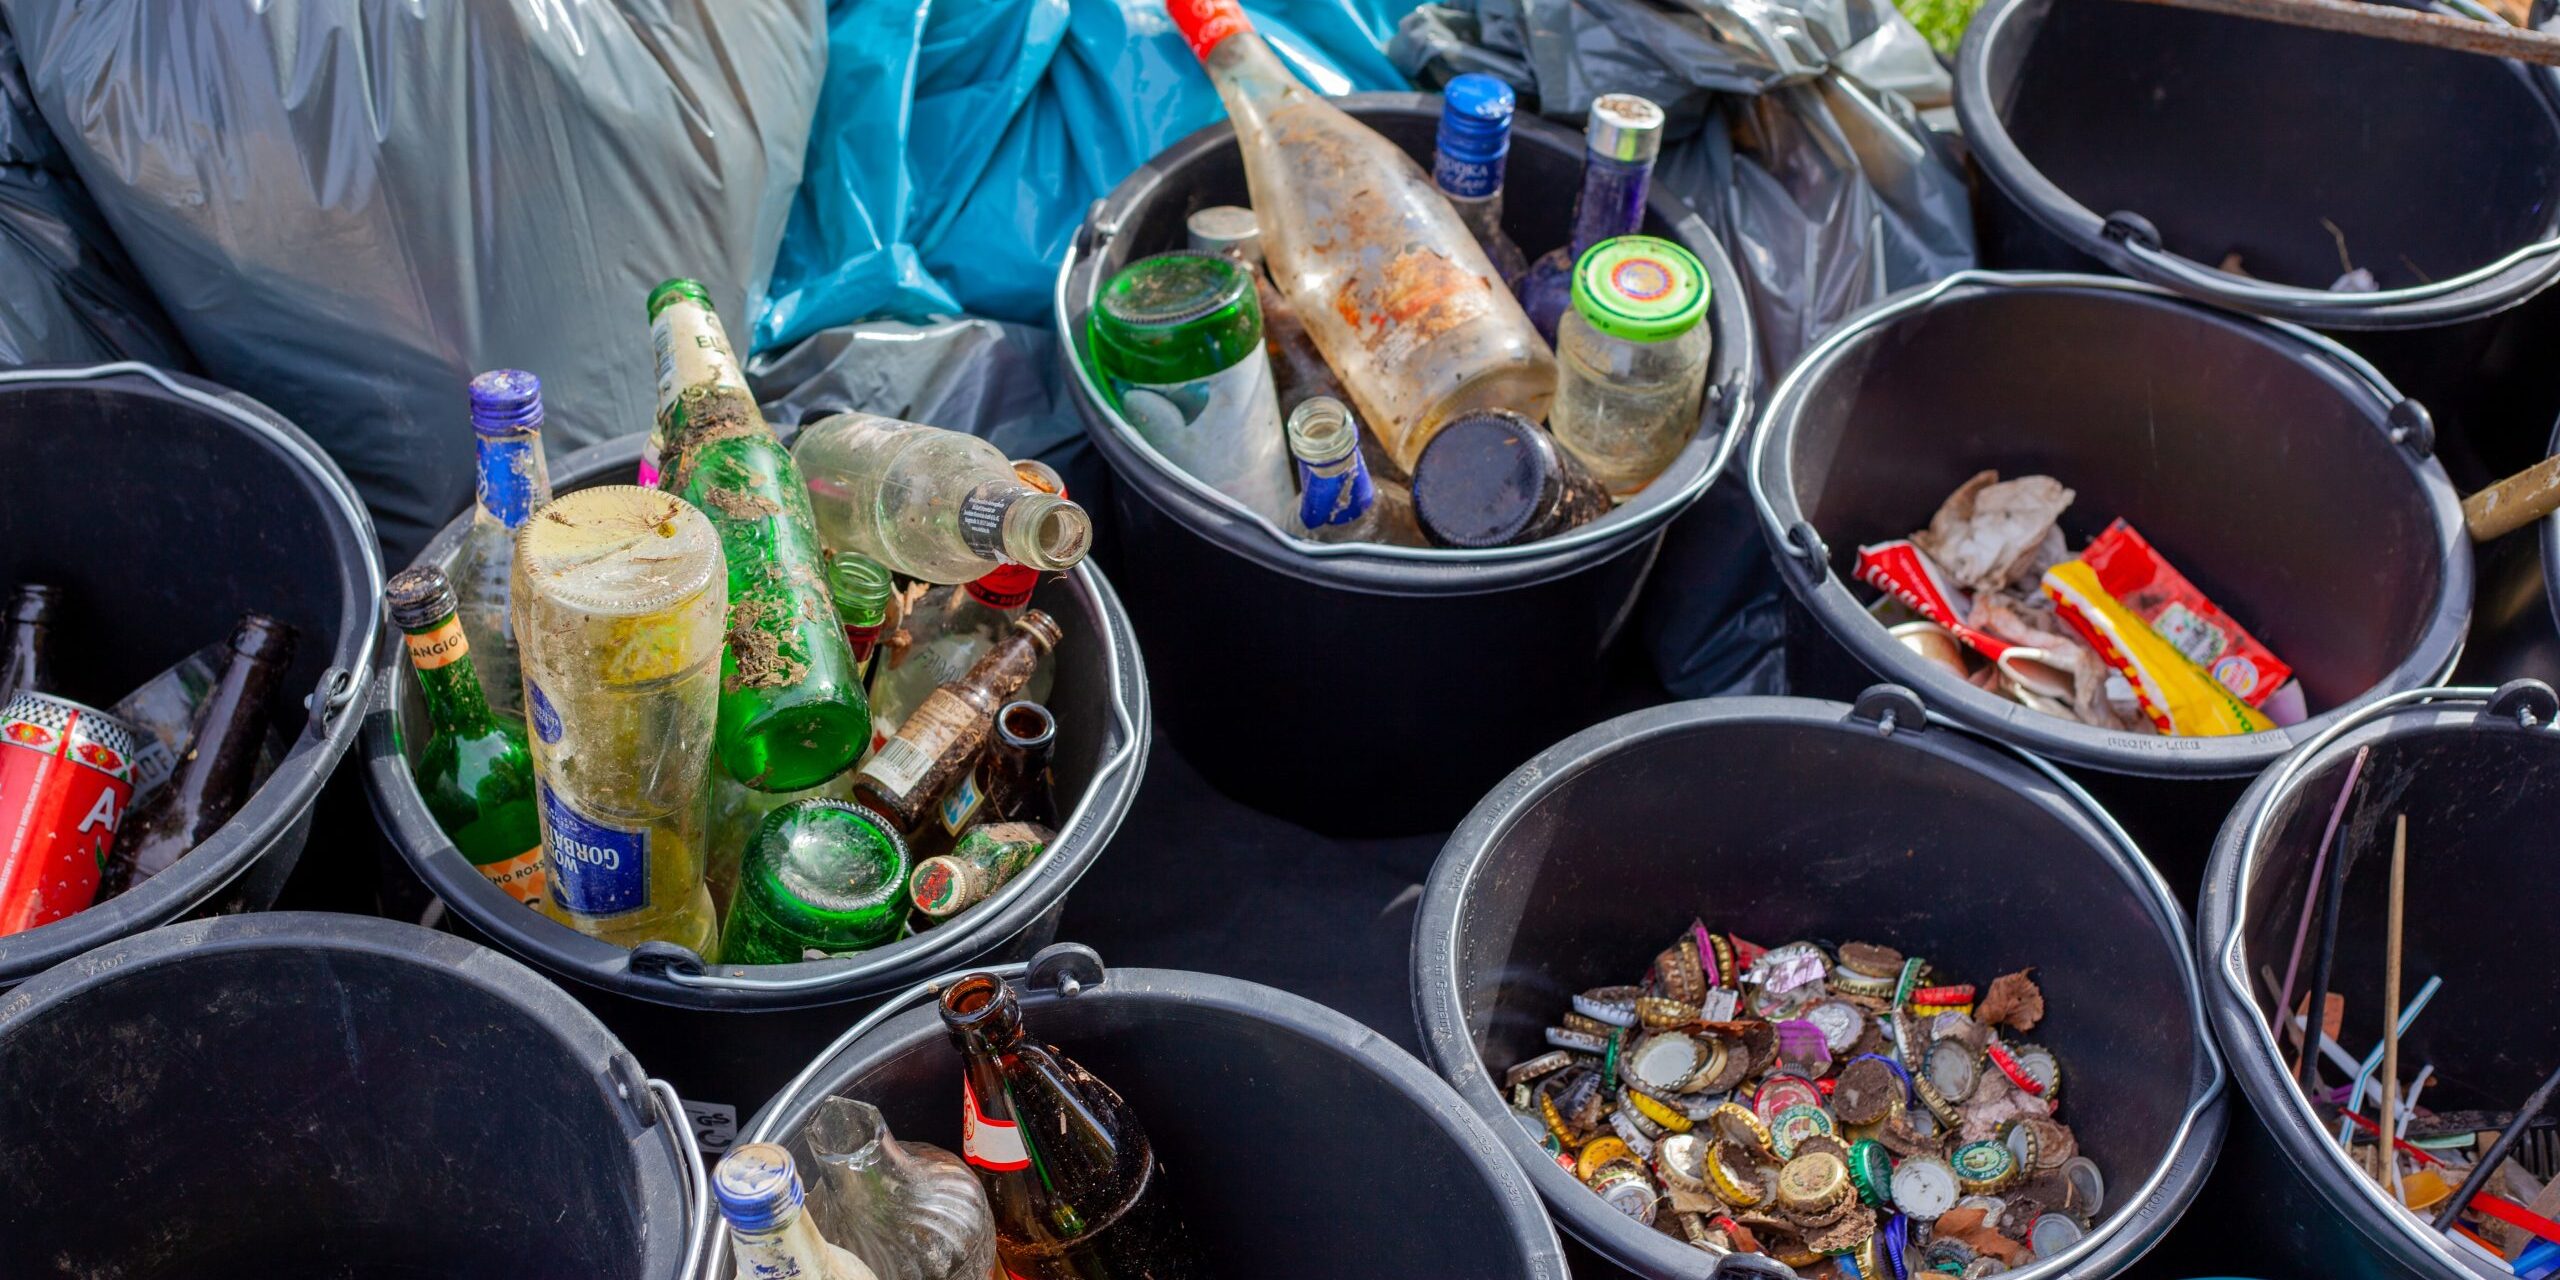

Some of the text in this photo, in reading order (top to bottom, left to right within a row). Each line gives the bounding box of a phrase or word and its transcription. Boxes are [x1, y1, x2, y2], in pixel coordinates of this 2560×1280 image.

[409, 631, 464, 658] ANGIOV
[78, 785, 124, 834] A
[1434, 930, 1453, 1035] Made in Germany
